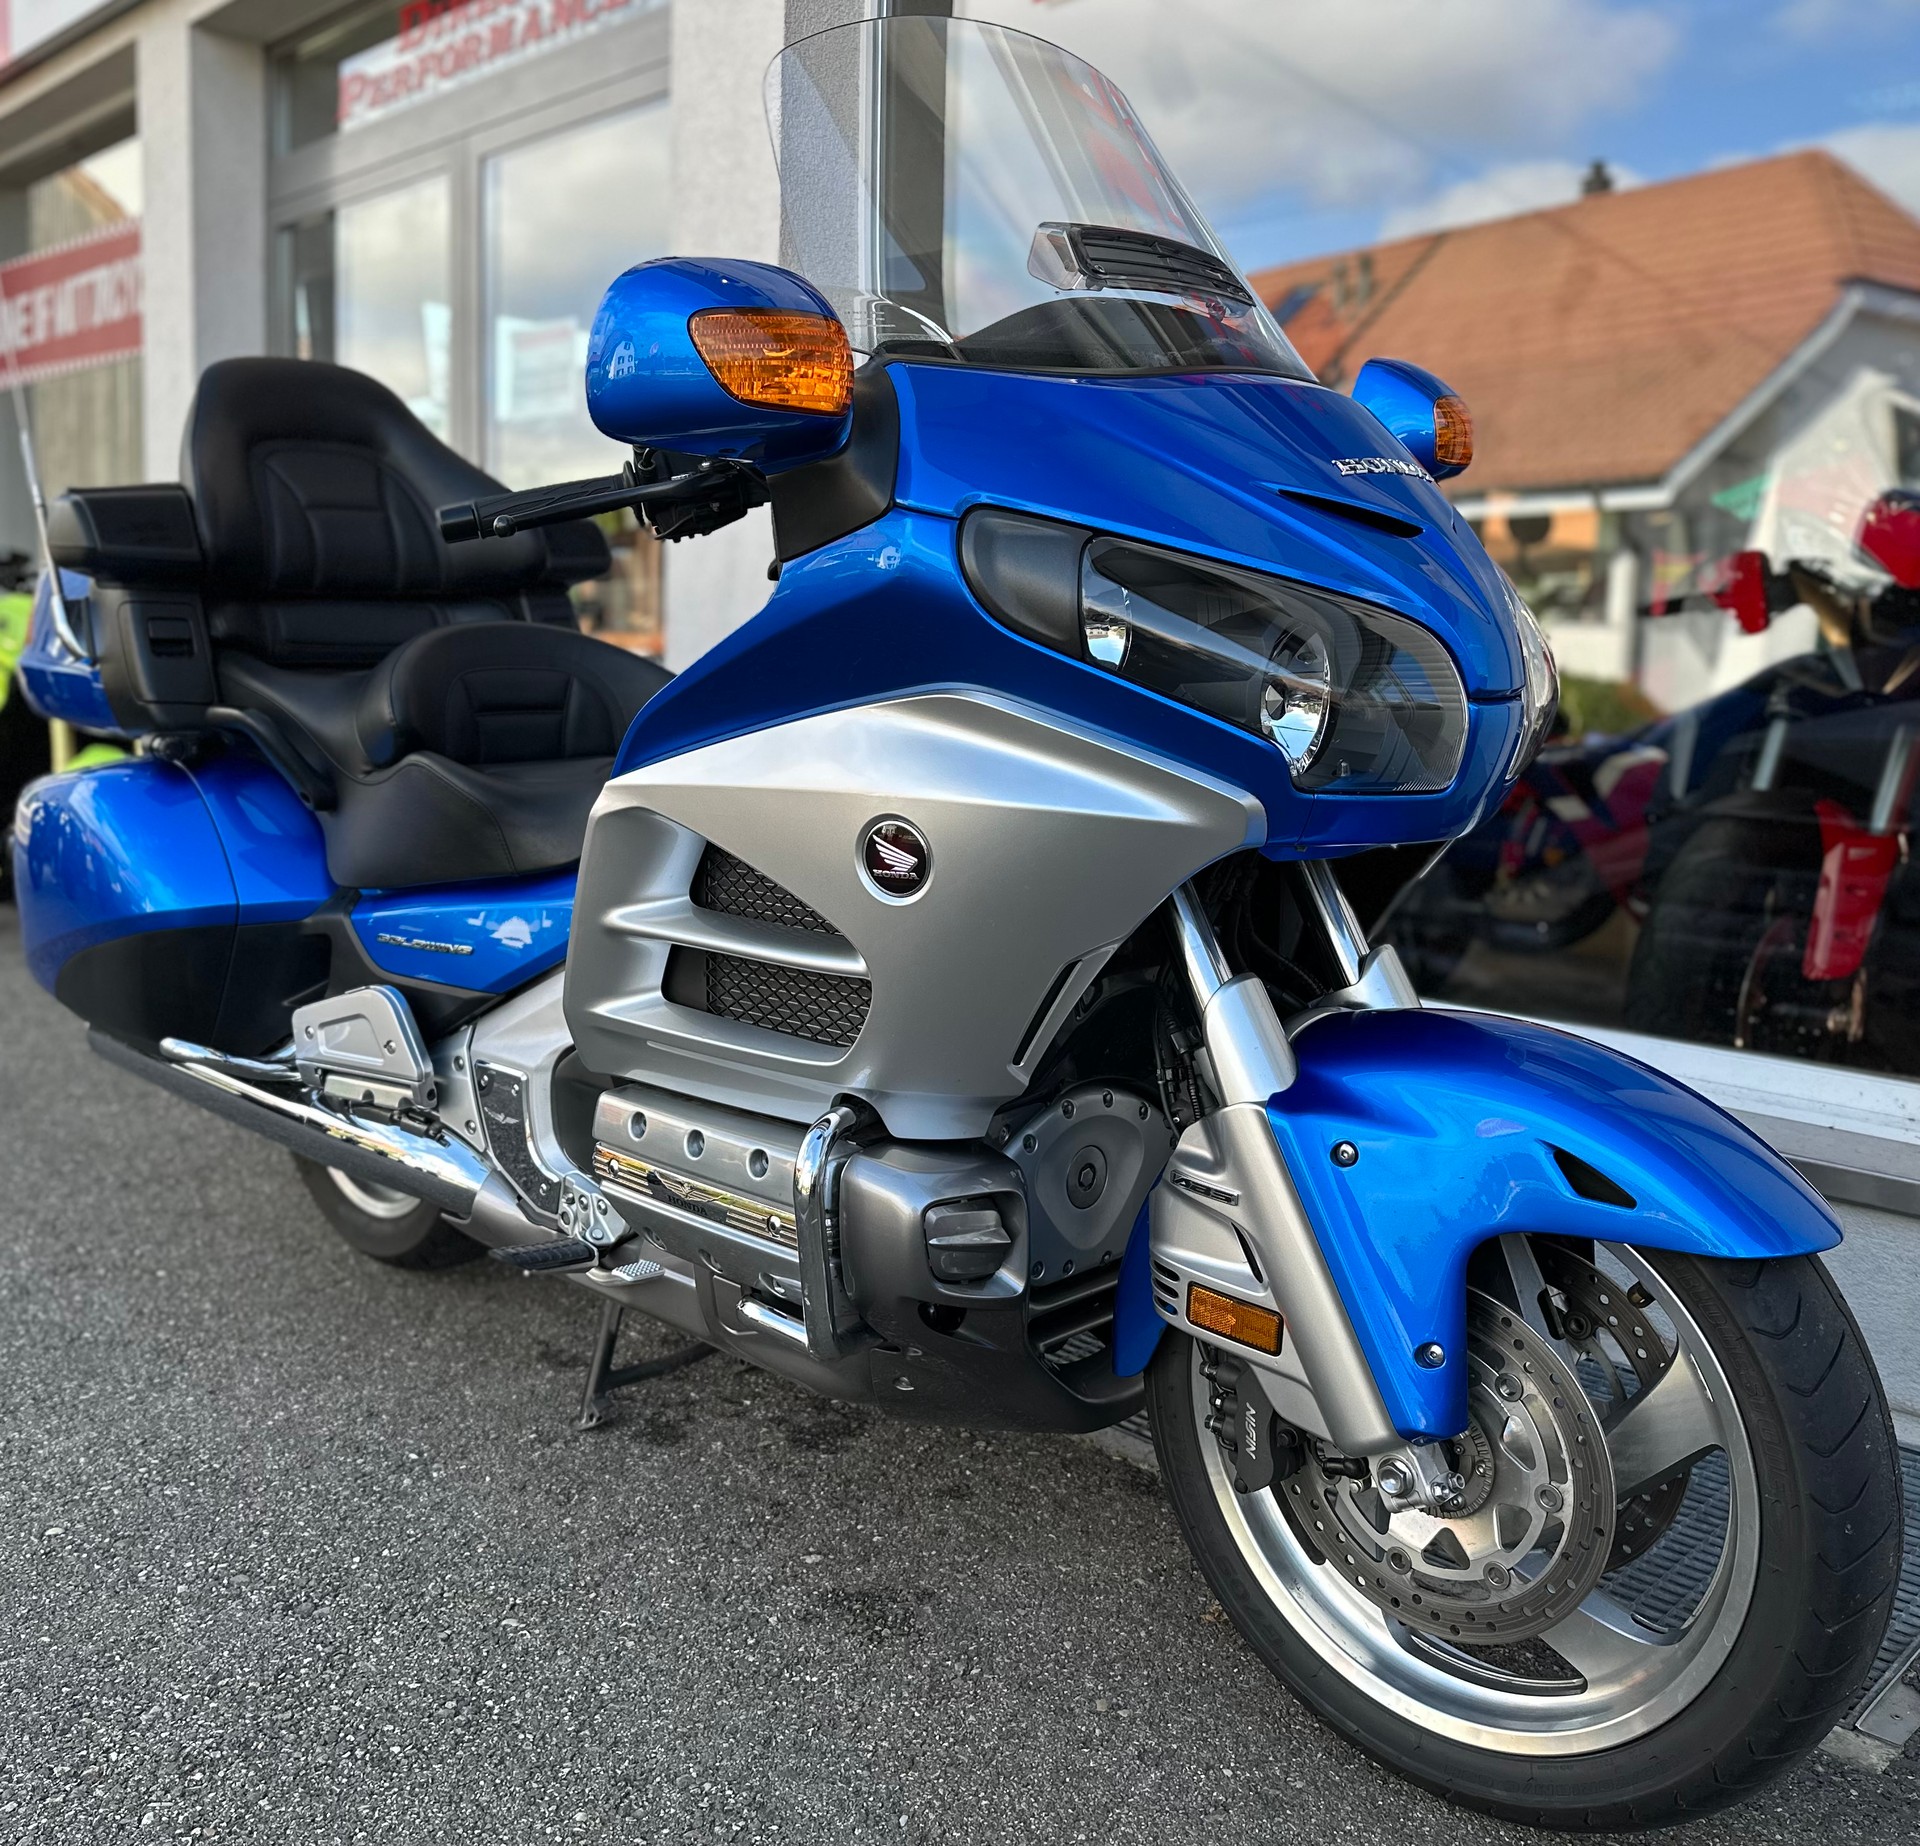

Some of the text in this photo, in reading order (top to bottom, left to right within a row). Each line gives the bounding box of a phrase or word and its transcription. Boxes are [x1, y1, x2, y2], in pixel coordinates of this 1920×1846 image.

[1331, 458, 1435, 482] HONDA
[873, 869, 919, 880] HONDA
[666, 1194, 708, 1216] HONDA
